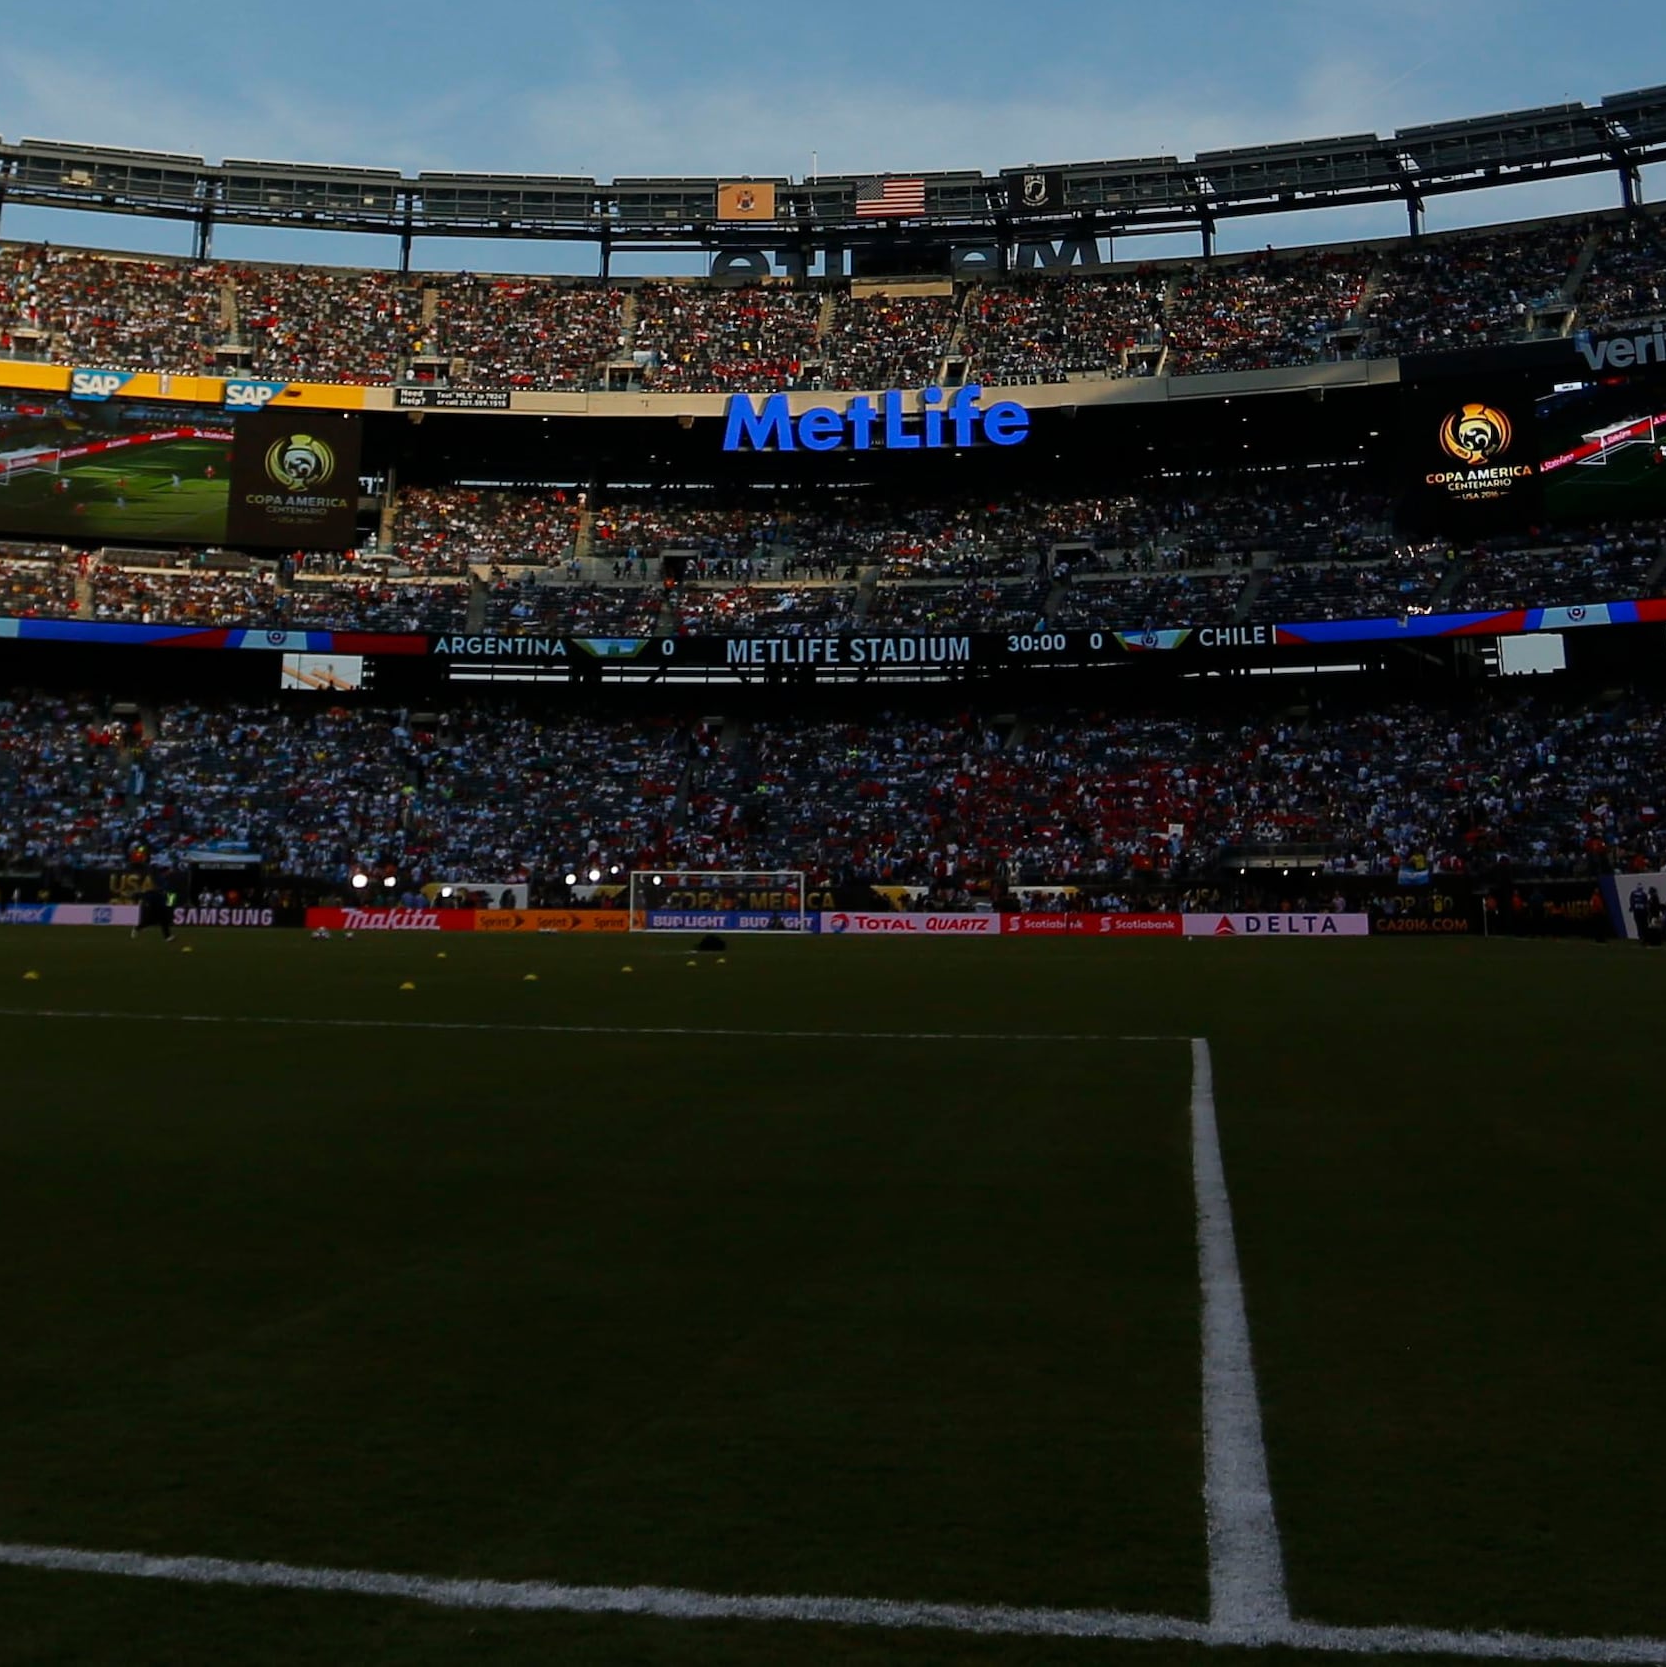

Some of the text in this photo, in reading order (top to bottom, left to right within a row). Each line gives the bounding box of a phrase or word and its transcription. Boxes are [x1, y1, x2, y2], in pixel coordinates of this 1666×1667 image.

[71, 374, 121, 396] SAP
[400, 389, 424, 398] Need
[225, 384, 273, 406] SAP
[400, 397, 426, 406] Help?
[721, 384, 1031, 452] MetLife
[1425, 464, 1533, 484] COPA AMERICA
[1447, 478, 1512, 491] CENTENARIO
[244, 493, 349, 508] COPA AMERICA
[1461, 493, 1480, 501] USA
[1006, 634, 1067, 652] 30:00
[1089, 632, 1103, 650] 0
[1198, 625, 1266, 647] CHILE
[433, 636, 568, 656] ARGENTINA
[661, 639, 675, 656] 0
[726, 636, 970, 664] METLIFE STADIUM
[172, 907, 274, 927] SAMSUNG
[340, 907, 442, 930] Makita
[480, 916, 511, 929] Sprint
[537, 916, 568, 929] Sprint
[594, 917, 624, 929] Sprint
[652, 916, 727, 929] BUD LIGHT
[855, 916, 990, 931] TOTAL QUARTZ
[1114, 918, 1175, 931] Scotiabank
[1245, 916, 1338, 933] DELTA
[1375, 917, 1469, 932] CA2016.COM
